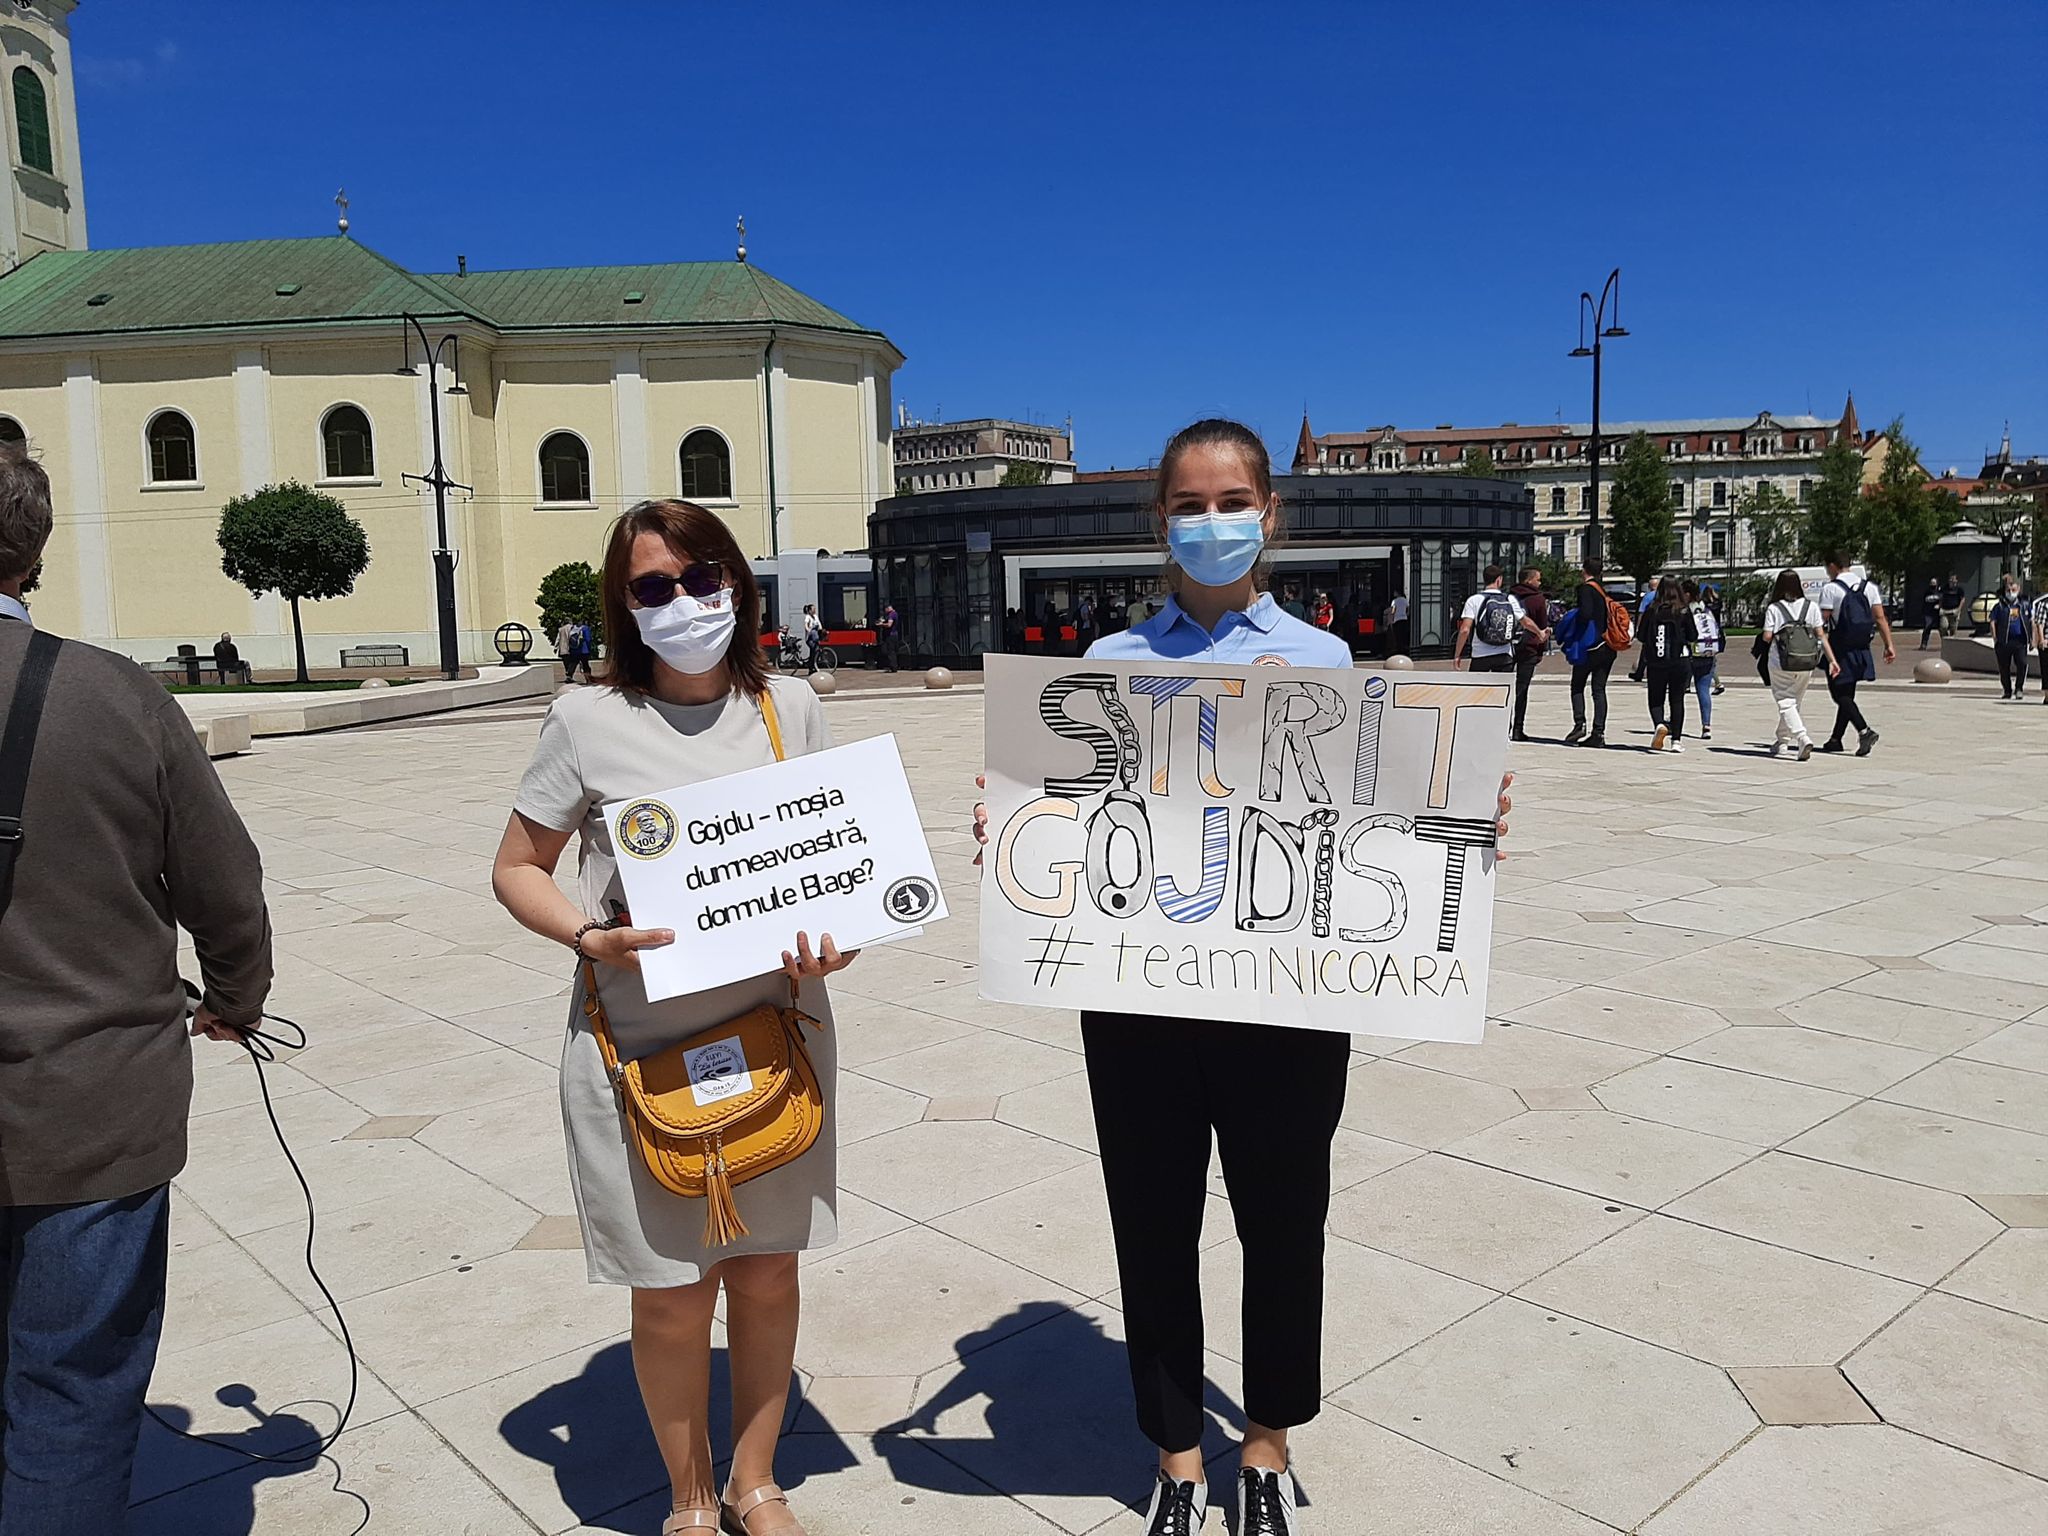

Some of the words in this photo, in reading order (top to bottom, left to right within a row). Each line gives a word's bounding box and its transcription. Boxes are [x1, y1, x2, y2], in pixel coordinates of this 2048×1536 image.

[1505, 614, 1514, 640] arena
[1655, 624, 1666, 658] adidas
[687, 810, 755, 846] Gojdu
[776, 786, 845, 821] moșia
[636, 836, 657, 848] 100
[686, 818, 869, 891] dumneavoastră,
[697, 886, 798, 932] domnule
[799, 858, 875, 901] Blage?
